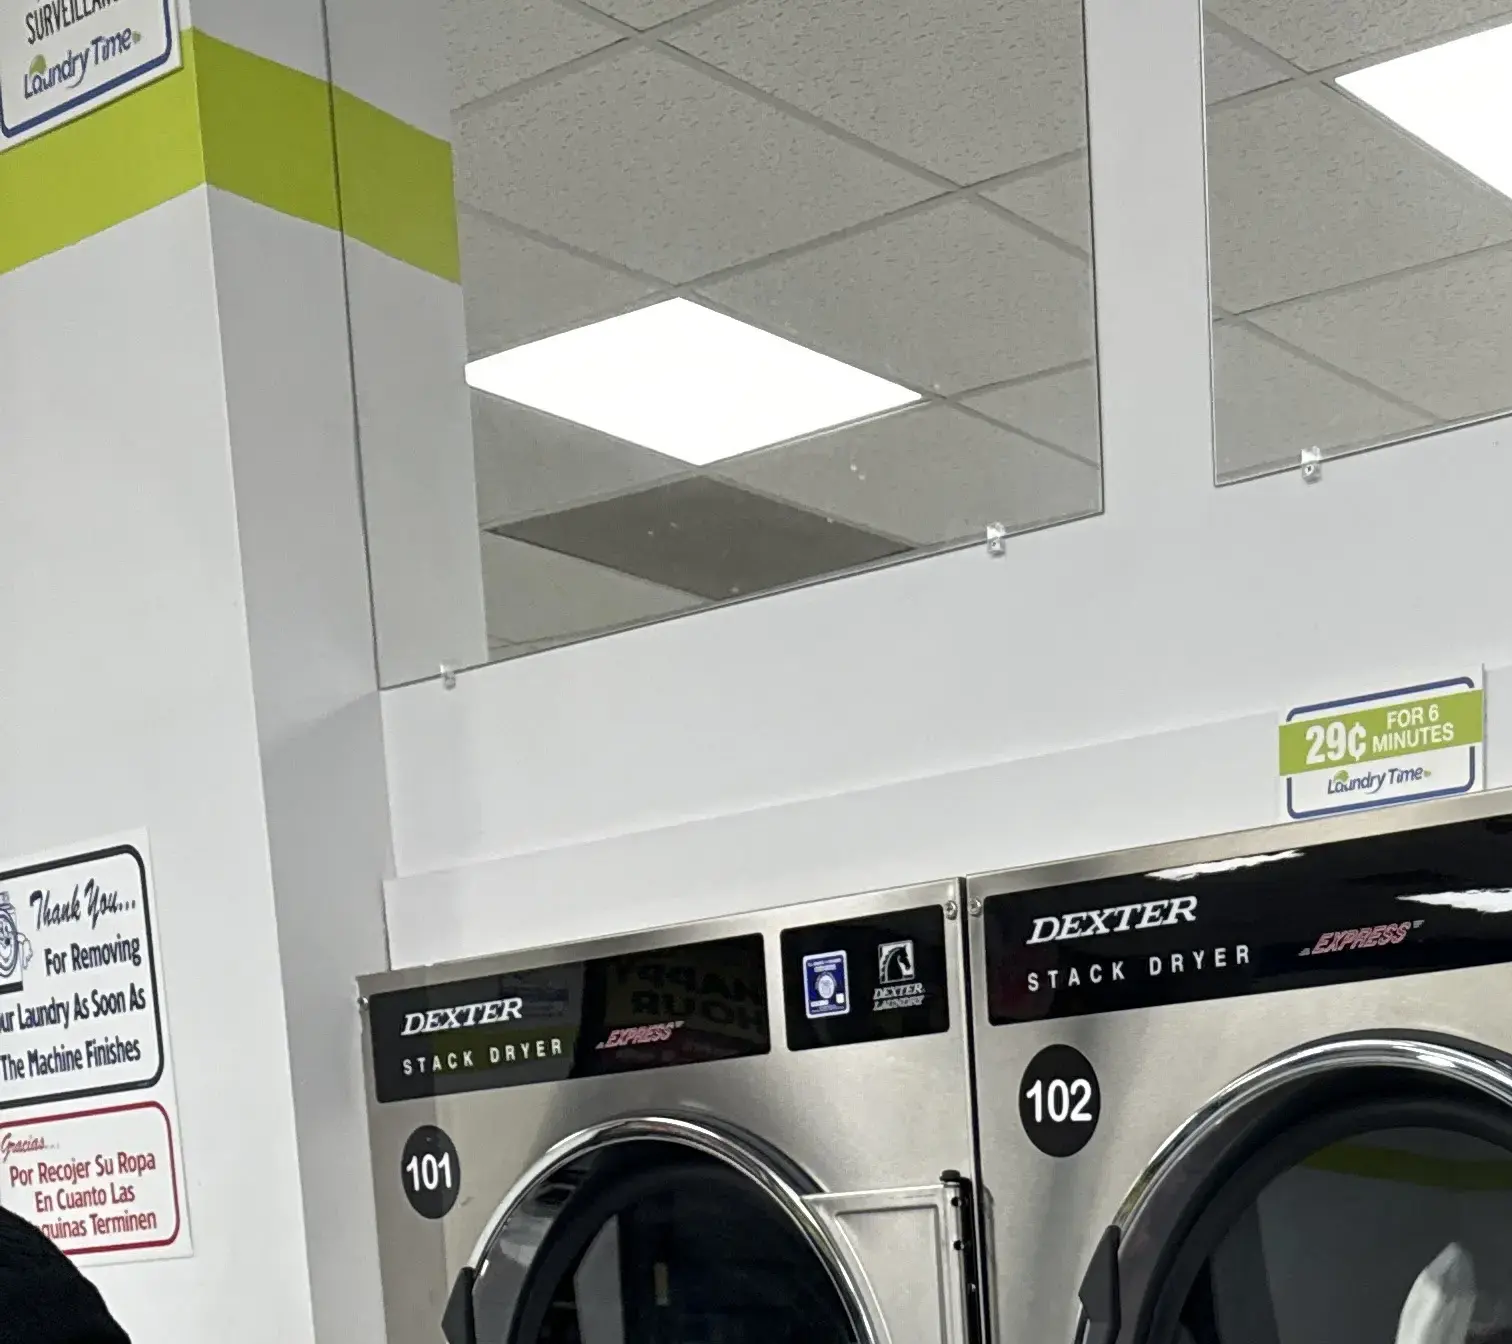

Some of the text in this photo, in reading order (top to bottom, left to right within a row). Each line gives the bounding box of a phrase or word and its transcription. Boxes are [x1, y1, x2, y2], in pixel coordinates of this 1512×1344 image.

[25, 0, 121, 36] SURVEILLA
[24, 27, 131, 99] Laundry Time
[1306, 703, 1440, 765] 29¢ FOR 6
[1372, 722, 1454, 753] MINUTES
[1327, 766, 1423, 795] Laundry Time
[29, 883, 82, 931] Thank
[1026, 895, 1198, 945] DEXTER
[44, 932, 142, 977] For Removing
[1311, 920, 1412, 955] EXPRESS
[1028, 944, 1250, 992] STACK DRYER
[0, 982, 146, 1034] ur Laundry As Soon As
[872, 982, 923, 1000] DEXTER
[400, 996, 523, 1037] DEXTER
[603, 1021, 674, 1050] EXPRESS
[0, 1034, 141, 1082] The Machine Finishes
[403, 1037, 562, 1076] STACK DRYER
[1026, 1078, 1093, 1123] 102
[9, 1150, 157, 1188] Por Recojer Su Ropa
[405, 1150, 453, 1192] 101
[34, 1182, 136, 1213] En Cuanto Las
[36, 1210, 158, 1240] quinas Terminen
